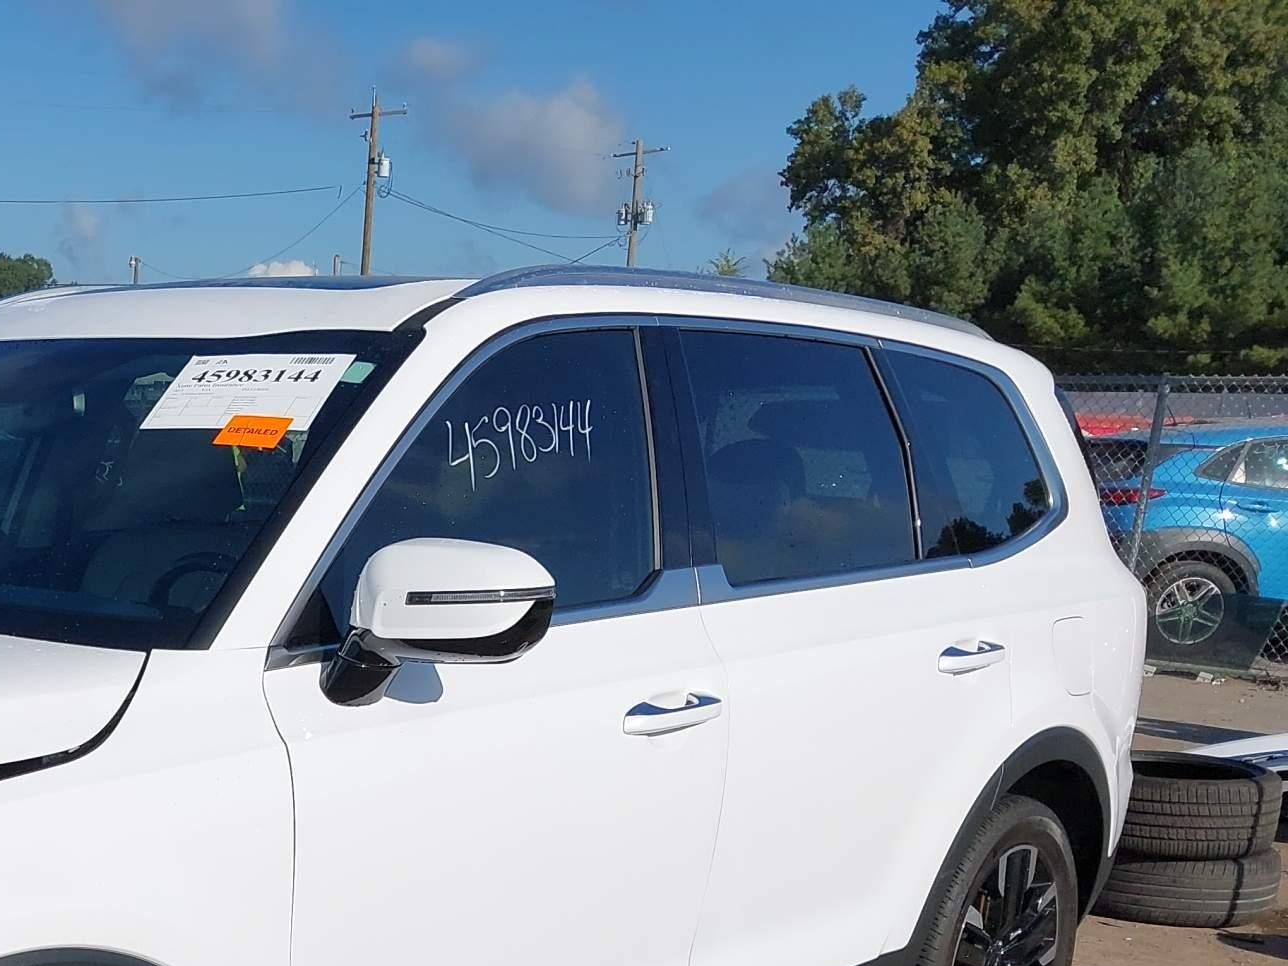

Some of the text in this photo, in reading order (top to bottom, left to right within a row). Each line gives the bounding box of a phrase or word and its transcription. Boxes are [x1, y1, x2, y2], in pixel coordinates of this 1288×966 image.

[191, 368, 323, 383] 45983144
[227, 426, 280, 436] DETAILED
[445, 399, 594, 493] 45983144
